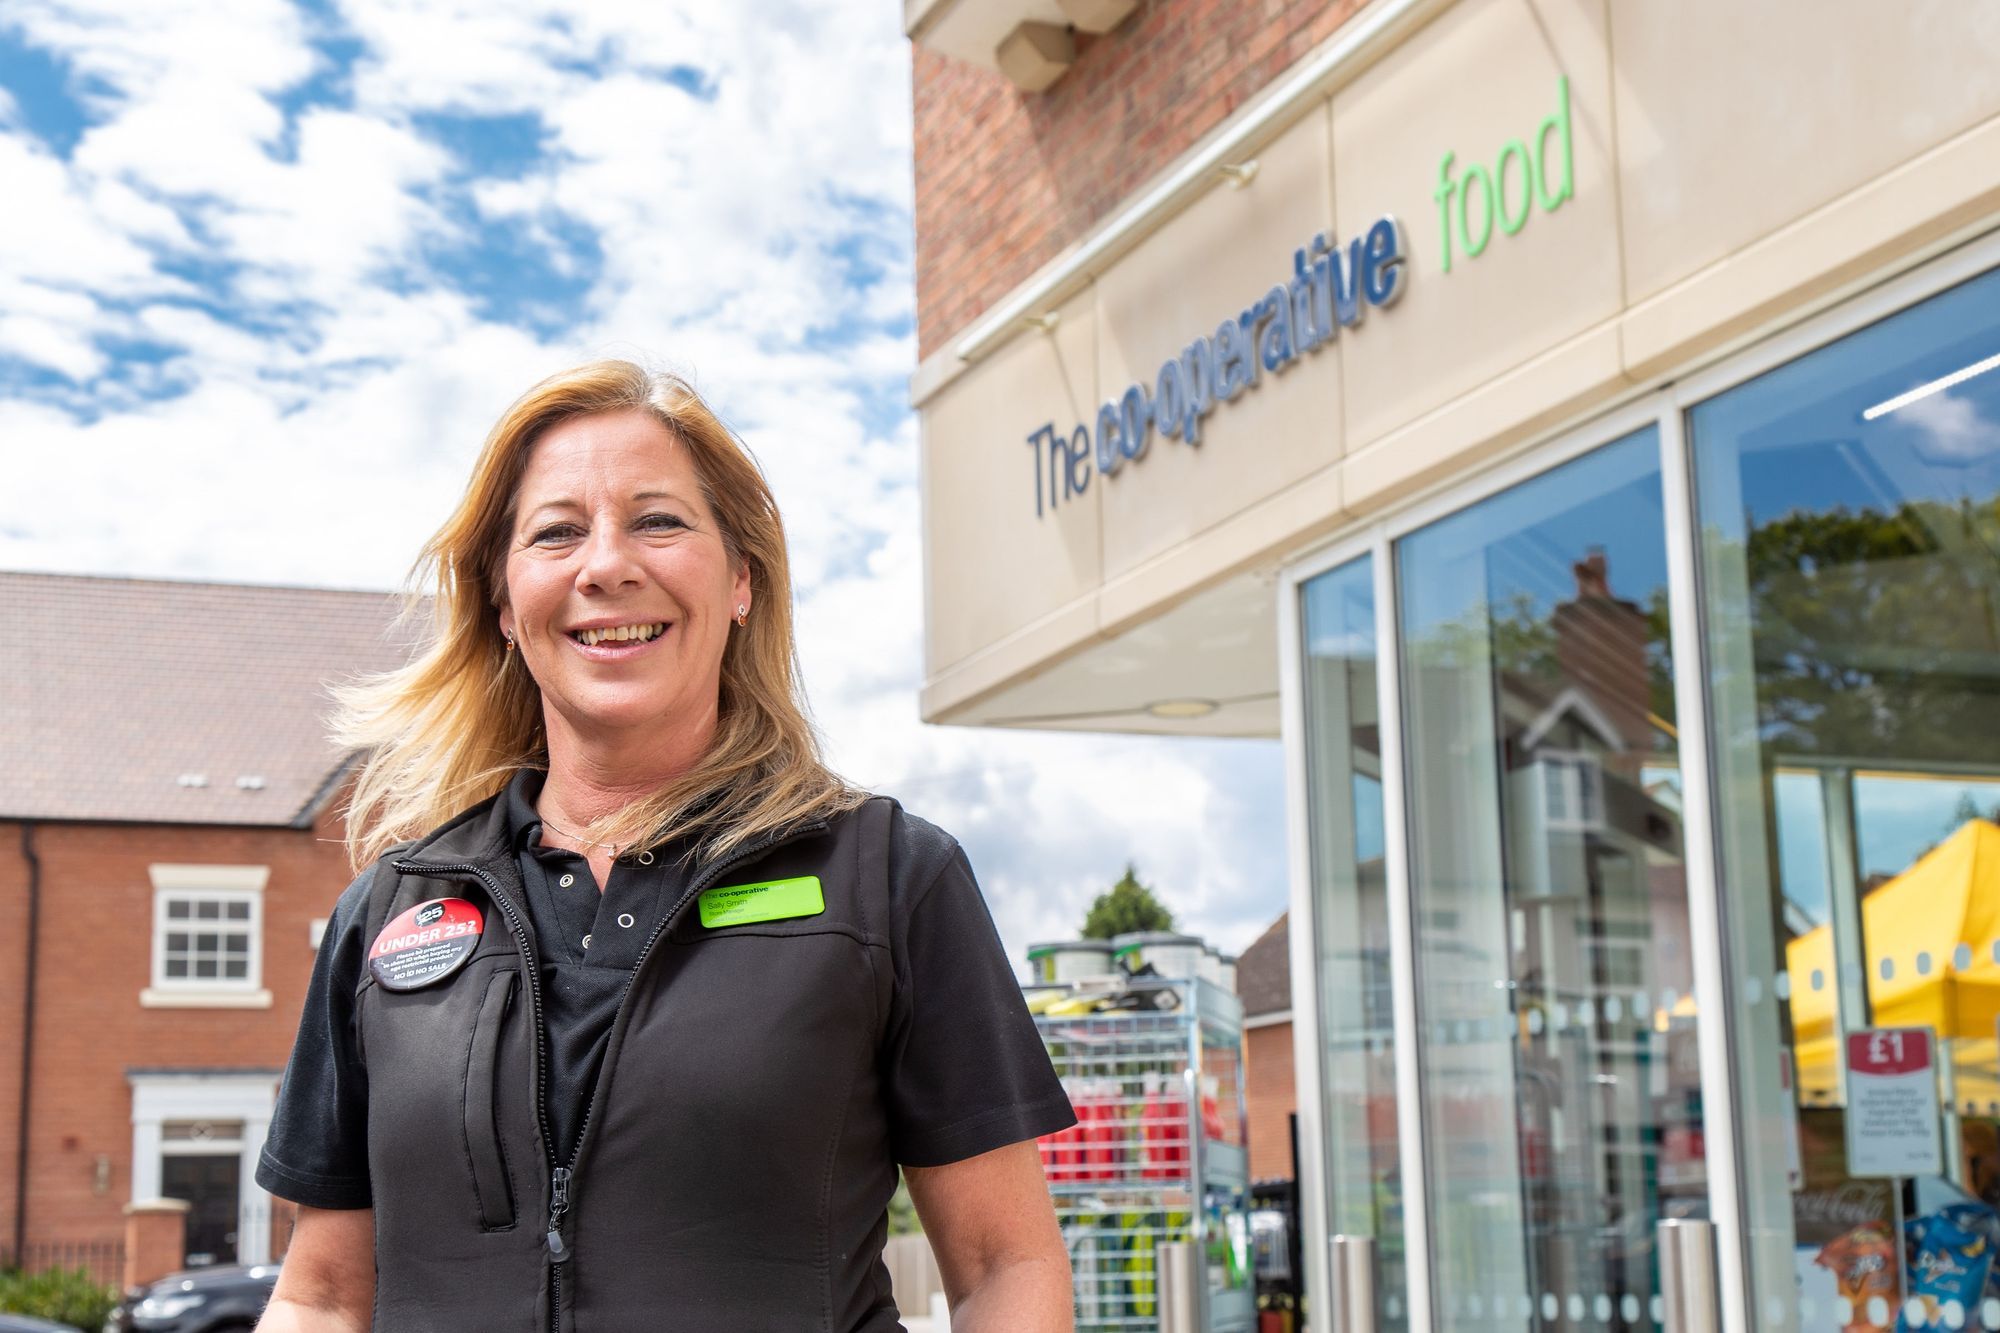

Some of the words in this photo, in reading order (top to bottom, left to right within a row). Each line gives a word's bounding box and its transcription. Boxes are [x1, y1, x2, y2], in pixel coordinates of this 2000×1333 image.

[1027, 420, 1090, 518] The
[1434, 74, 1574, 273] food
[726, 899, 748, 907] Smith
[379, 928, 440, 954] UNDER
[443, 920, 476, 938] 25?
[413, 954, 430, 962] when
[430, 948, 451, 957] buying
[423, 943, 451, 954] prepared
[429, 953, 454, 963] product
[393, 972, 406, 980] NO
[415, 967, 428, 975] NO
[427, 962, 447, 972] SALE
[1868, 1031, 1903, 1062] £1
